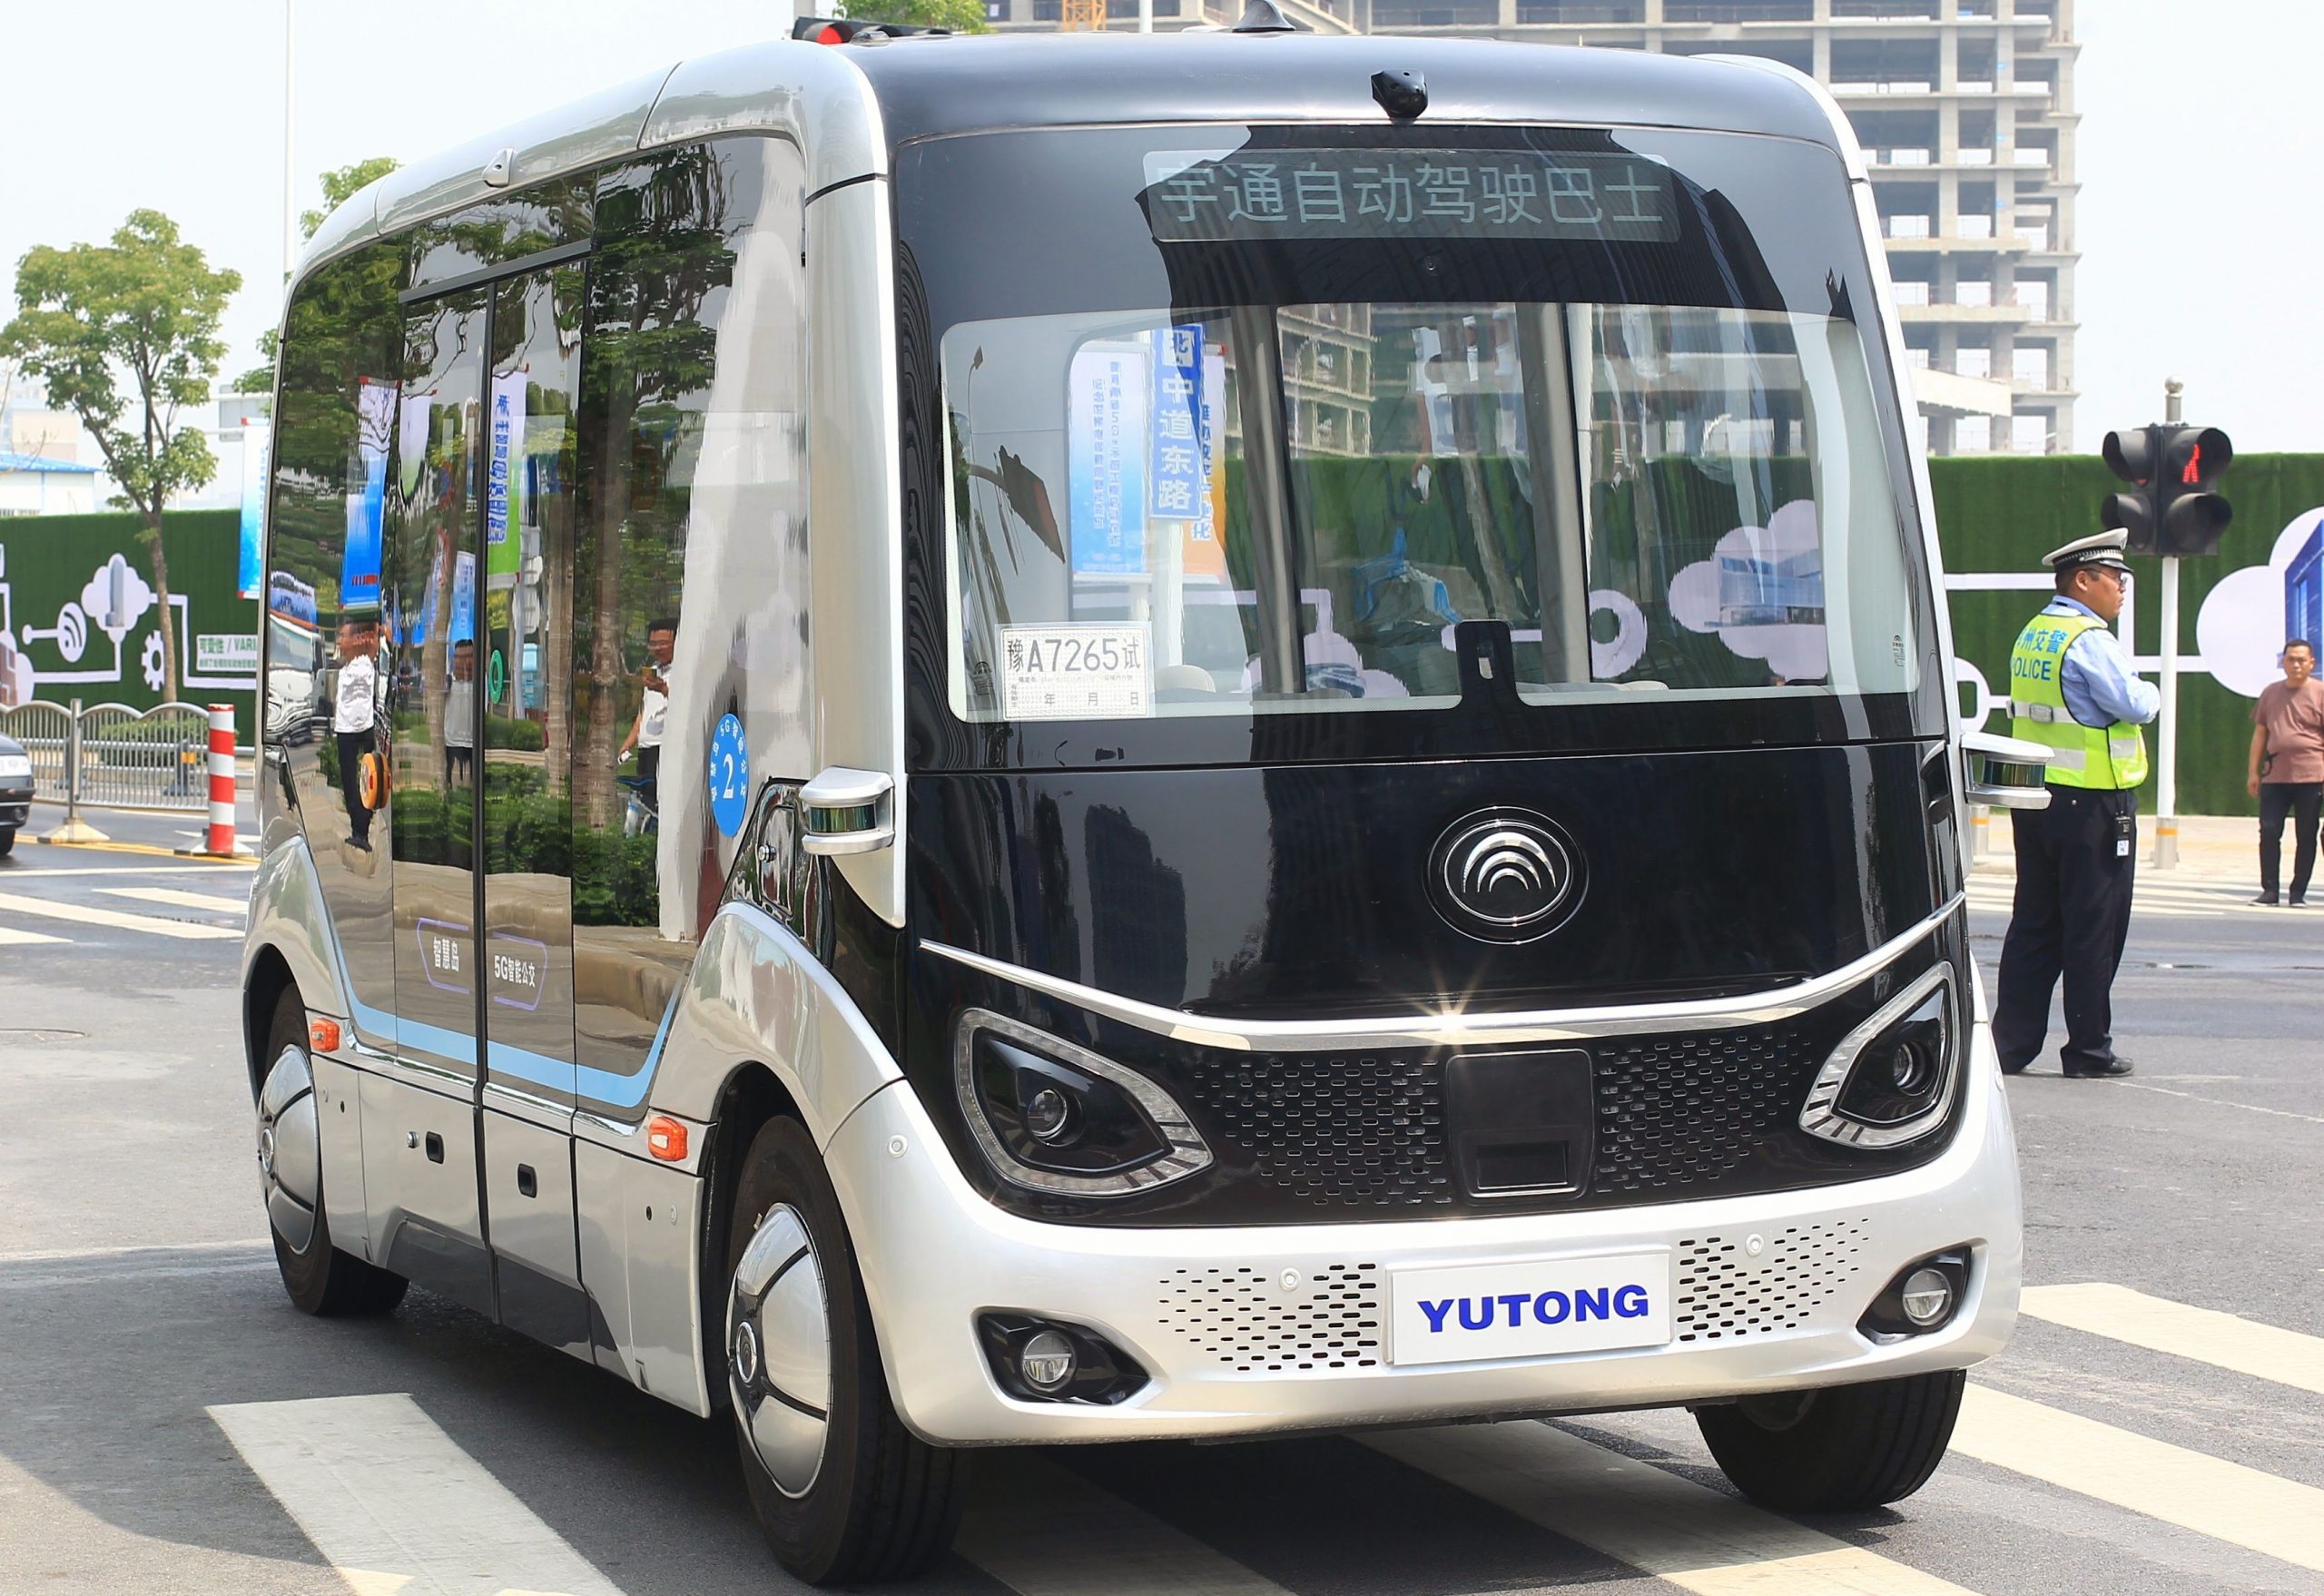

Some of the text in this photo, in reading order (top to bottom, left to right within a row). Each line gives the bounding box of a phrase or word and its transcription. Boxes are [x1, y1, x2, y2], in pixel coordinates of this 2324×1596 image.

[1158, 163, 1663, 224] 宇通自动驾驶巴士
[1159, 373, 1193, 509] 中道东路
[1008, 636, 1141, 673] 豫A7265试
[723, 753, 734, 799] 2
[434, 936, 459, 971] 智慧岛
[494, 955, 536, 988] 5G智能公交
[1416, 1284, 1649, 1333] YUTONG
